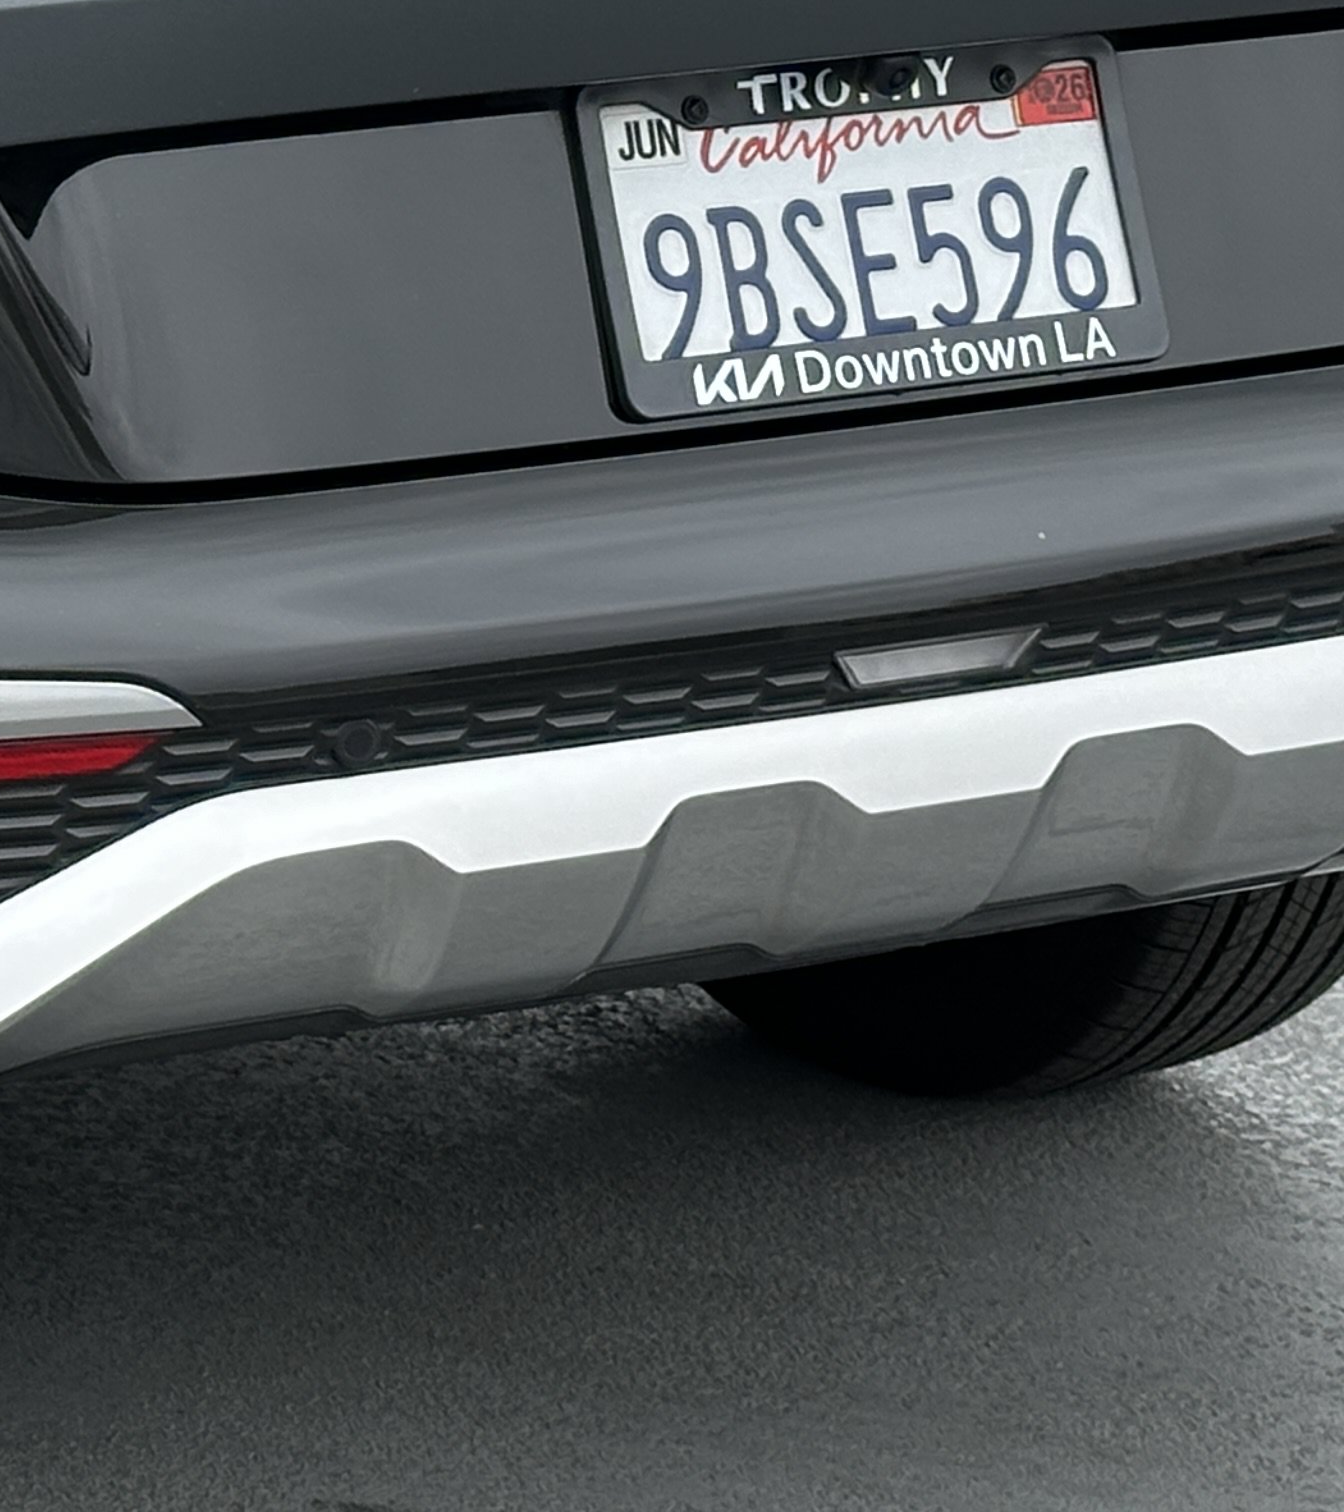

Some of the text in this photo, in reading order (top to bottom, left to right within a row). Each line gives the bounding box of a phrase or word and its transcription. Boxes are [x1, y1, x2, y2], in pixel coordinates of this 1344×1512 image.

[737, 55, 954, 115] TROY
[1055, 72, 1087, 102] 26
[617, 120, 682, 161] JUN
[699, 104, 1021, 184] California
[643, 166, 1110, 360] 9BSE596
[692, 315, 1117, 407] KIA Downtown LA
